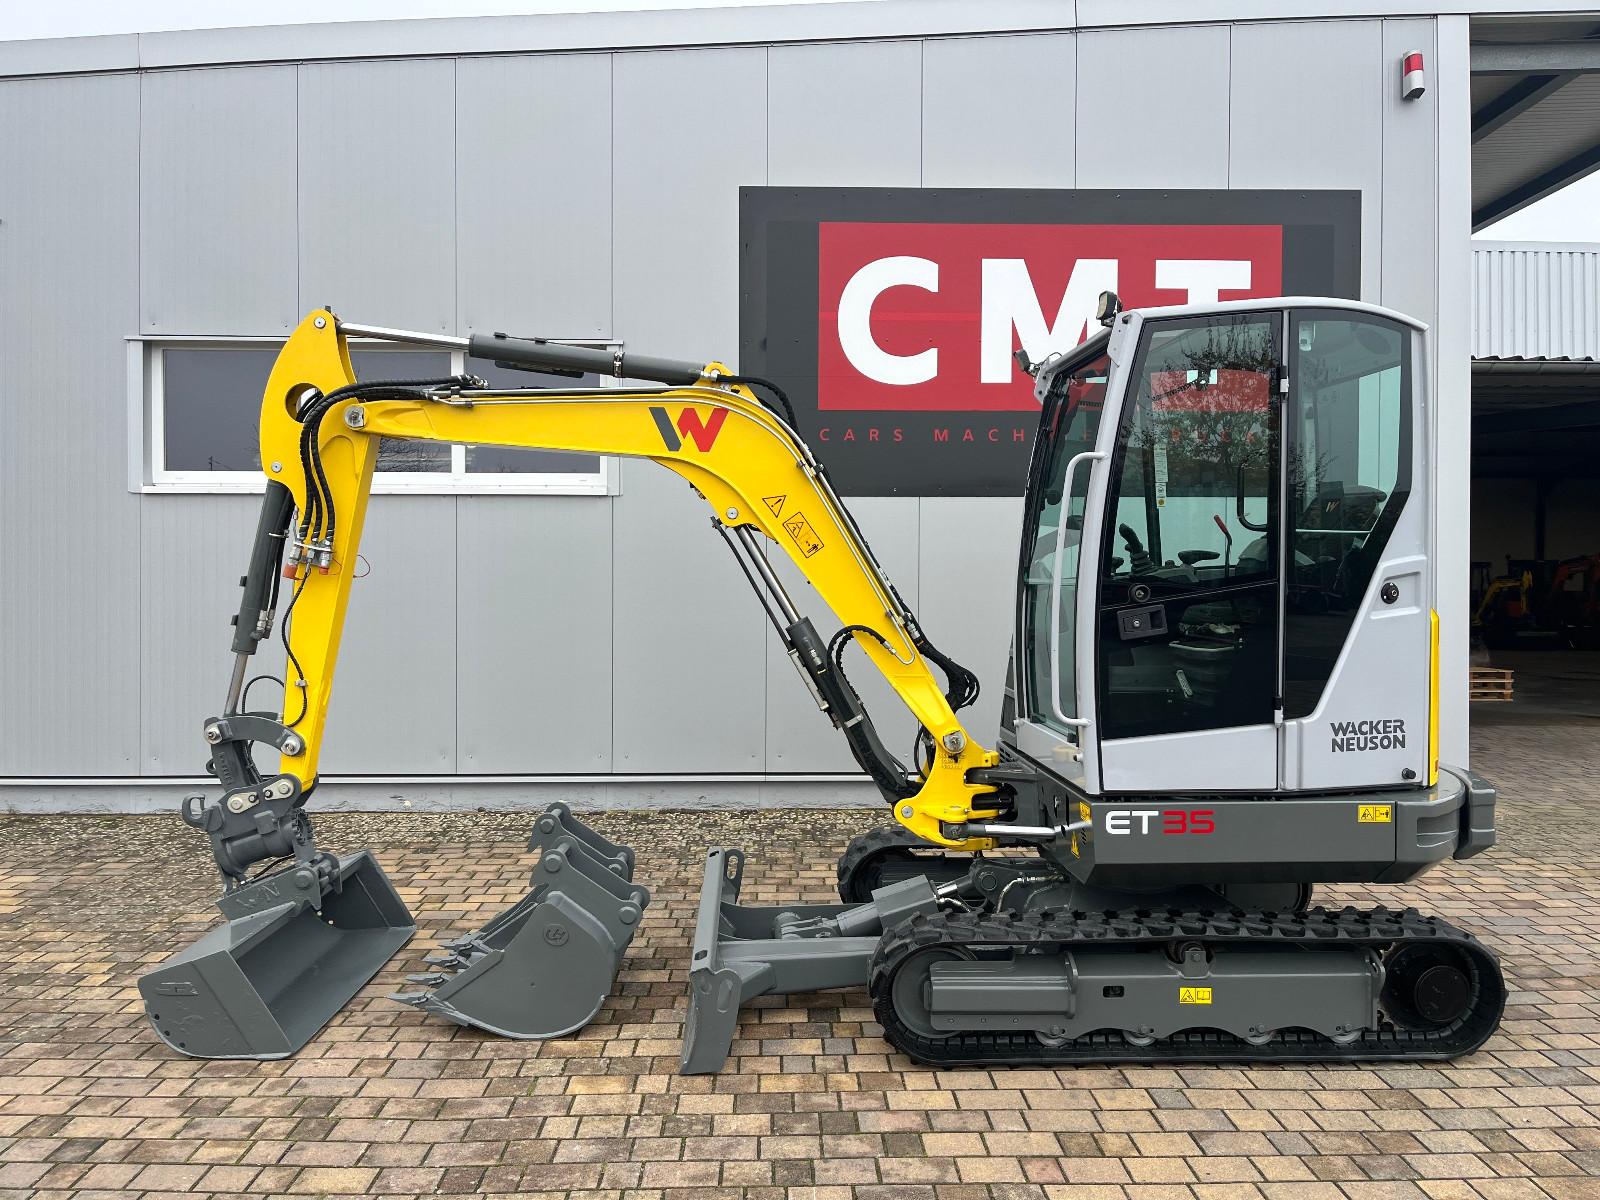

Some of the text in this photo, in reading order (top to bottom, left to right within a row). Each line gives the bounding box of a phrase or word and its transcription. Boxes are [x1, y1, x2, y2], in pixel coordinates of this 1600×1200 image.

[838, 255, 1252, 386] CMT
[819, 427, 904, 442] CARS
[1330, 719, 1406, 737] WACKER
[1331, 734, 1406, 753] NEUSON
